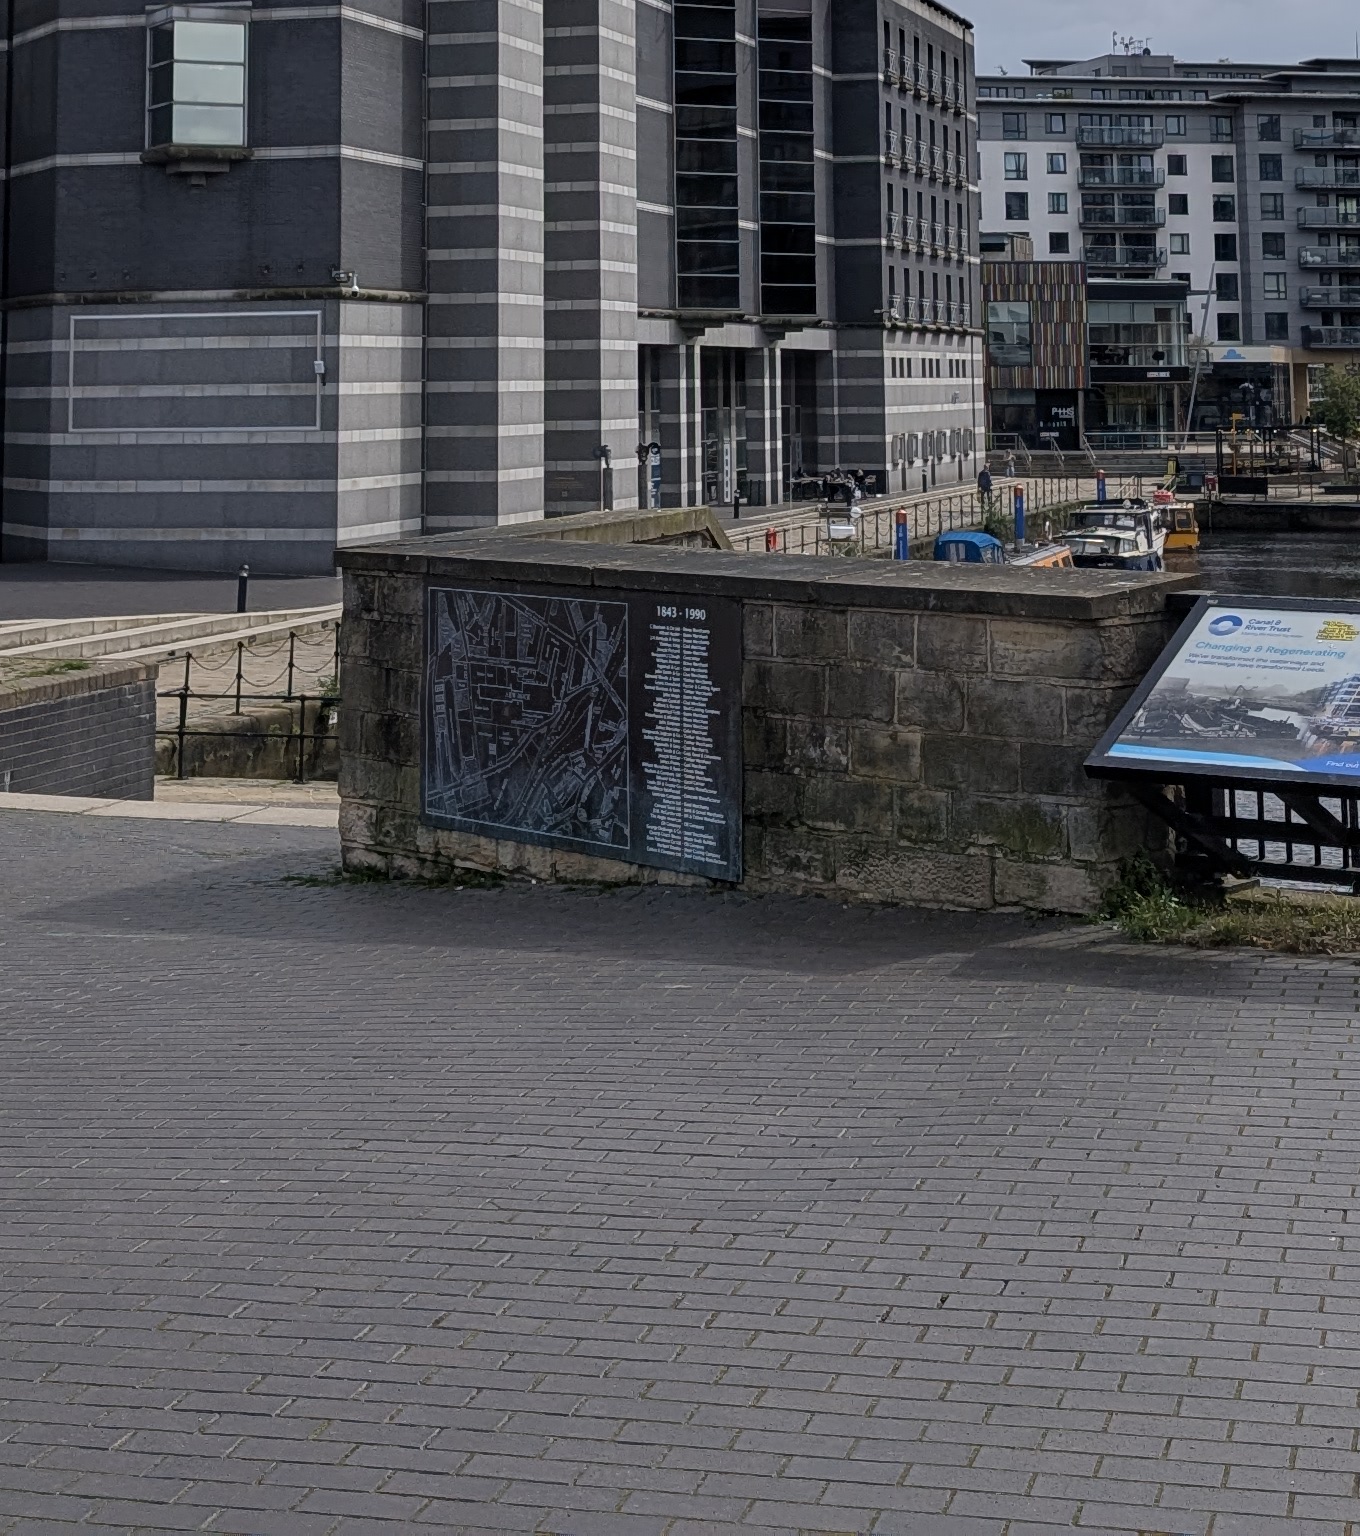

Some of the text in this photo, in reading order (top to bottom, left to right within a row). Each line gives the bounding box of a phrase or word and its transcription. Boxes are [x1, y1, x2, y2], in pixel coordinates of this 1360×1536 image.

[656, 605, 677, 618] 1843
[685, 607, 707, 621] 1990
[1248, 618, 1274, 626] Canal
[1244, 624, 1292, 633] River Trust
[1195, 641, 1347, 660] Changing & Regenerating
